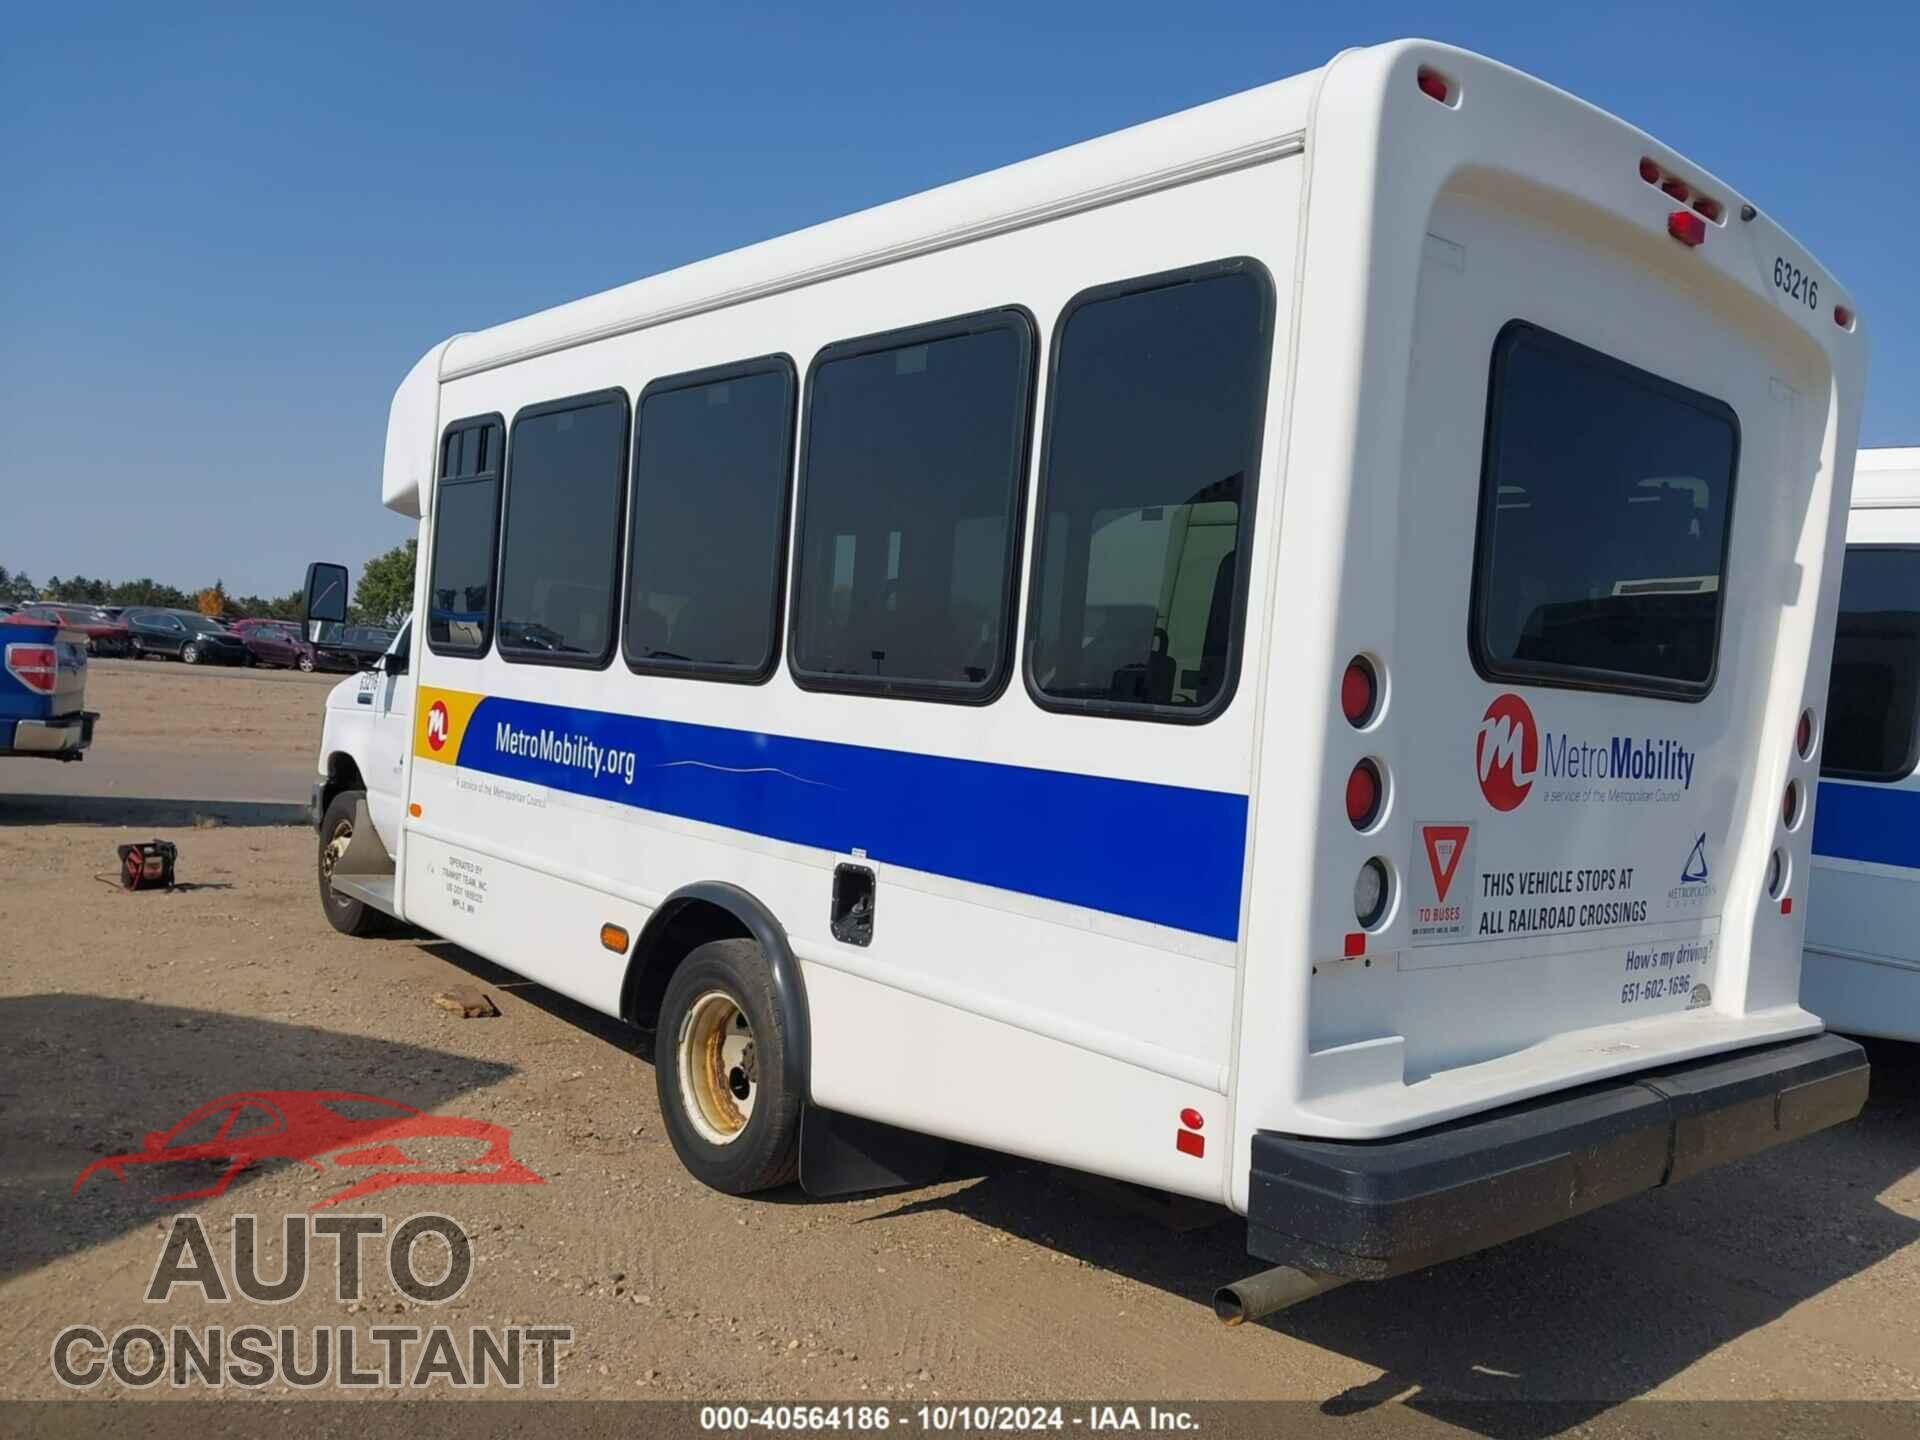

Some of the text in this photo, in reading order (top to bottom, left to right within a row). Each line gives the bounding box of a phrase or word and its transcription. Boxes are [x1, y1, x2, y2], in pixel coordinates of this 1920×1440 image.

[1774, 256, 1818, 310] 63216
[495, 721, 636, 785] MetroMobility.org
[1544, 732, 1695, 790] MetroMobility
[1482, 868, 1634, 897] THIS VEHICLE STOPS AT
[1419, 906, 1460, 922] TO BUSES
[1479, 911, 1504, 935] ALL
[1508, 905, 1576, 932] RAILROAD
[1579, 900, 1648, 927] CROSSINGS
[1625, 940, 1713, 971] How's my driving?
[1621, 974, 1691, 1004] 651-602-1696
